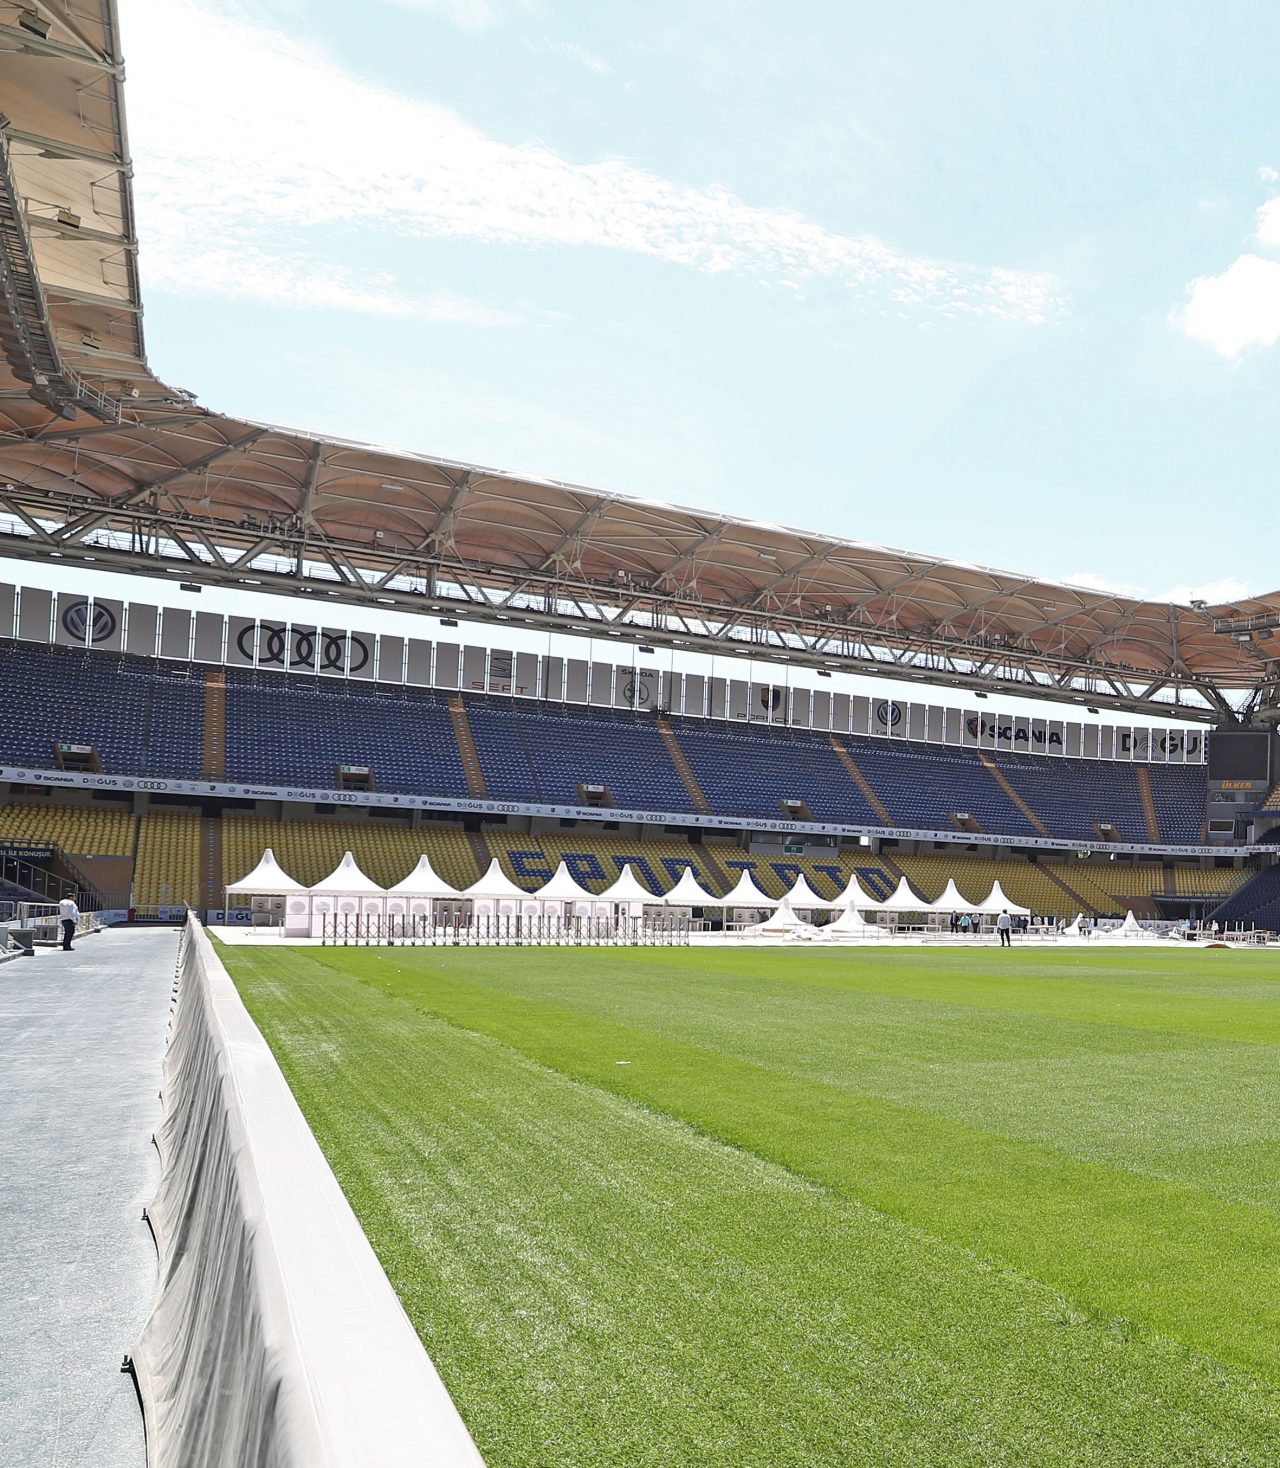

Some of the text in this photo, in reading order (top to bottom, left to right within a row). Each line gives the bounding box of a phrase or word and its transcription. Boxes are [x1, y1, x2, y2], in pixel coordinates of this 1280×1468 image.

[471, 680, 529, 695] SEAT
[988, 723, 1063, 746] SCANIA
[43, 775, 75, 783] SCANIA
[1221, 780, 1252, 789] ÜLKER
